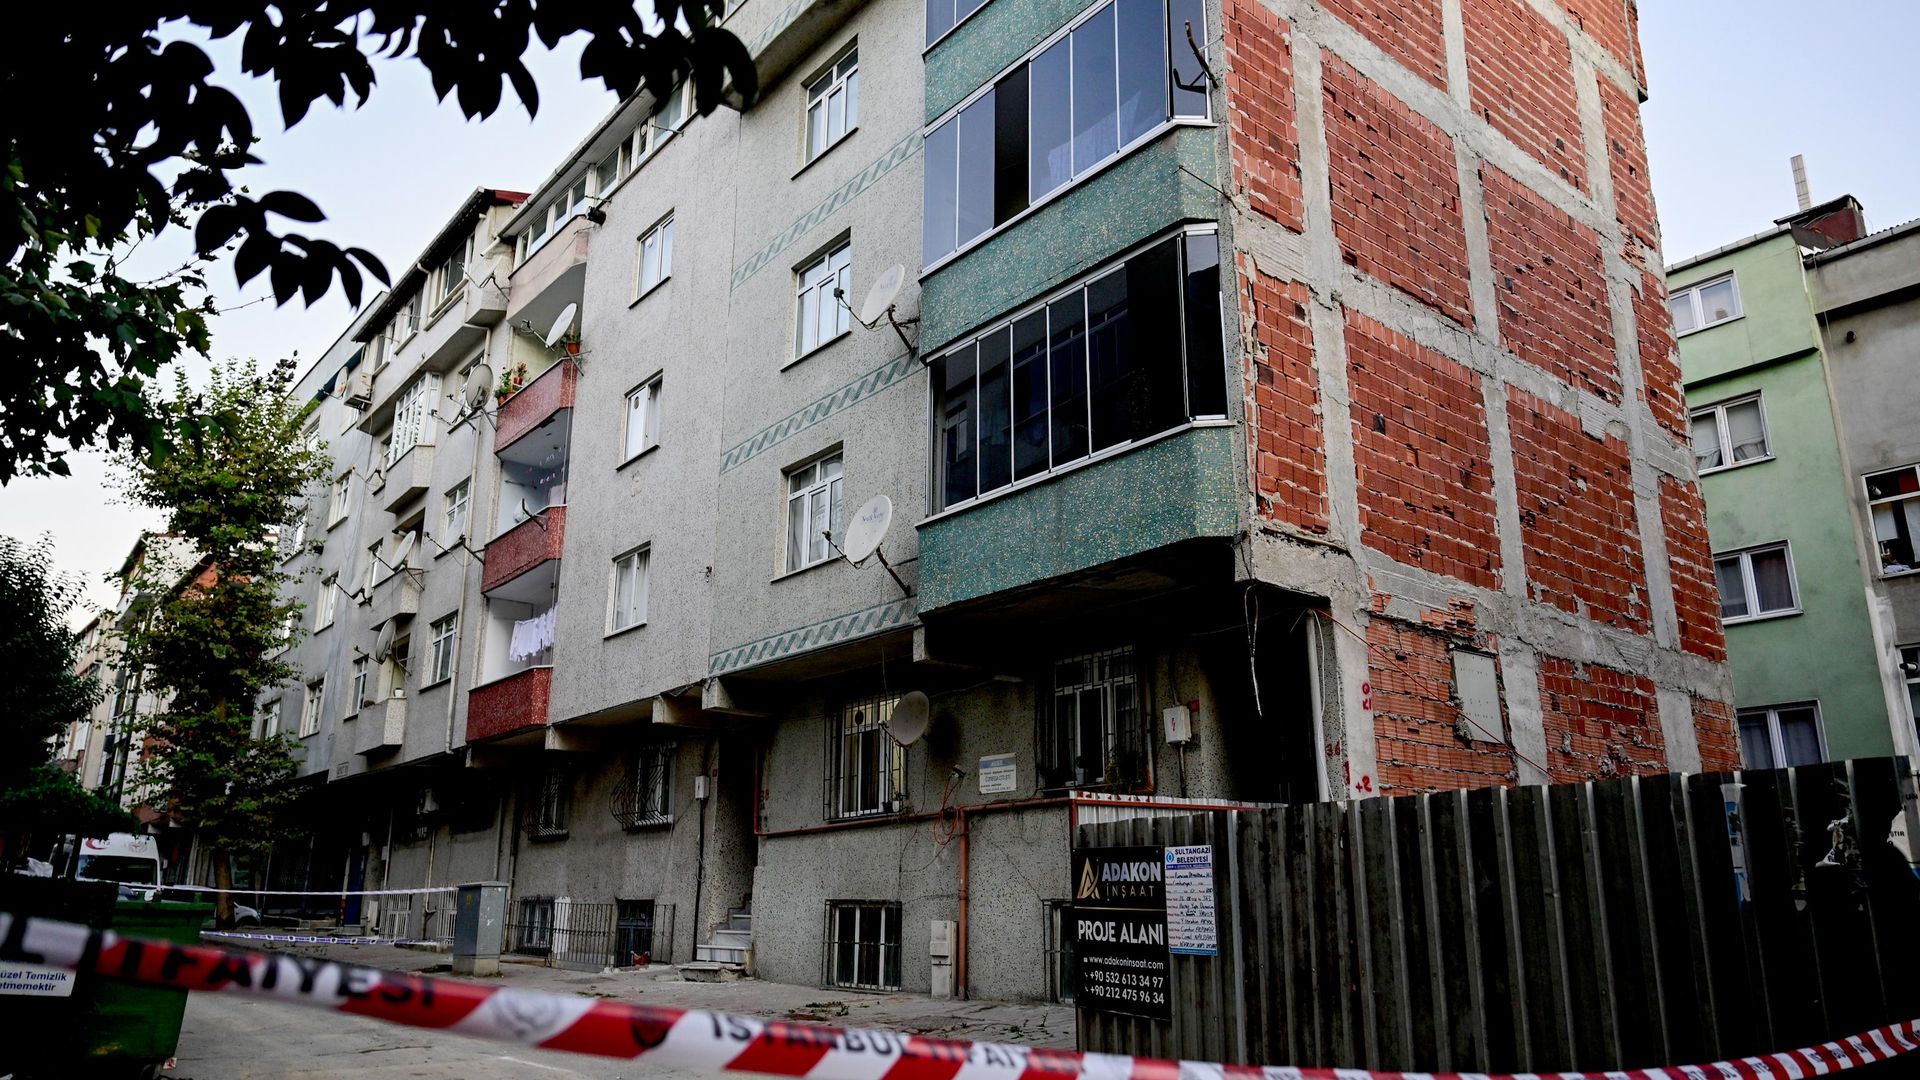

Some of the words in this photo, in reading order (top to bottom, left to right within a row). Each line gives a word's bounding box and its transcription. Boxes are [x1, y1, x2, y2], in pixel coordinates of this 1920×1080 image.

[1175, 846, 1211, 855] SULTANGAZİ
[1177, 855, 1209, 863] BELEDİYESİ
[1102, 862, 1161, 882] ADAKON
[1106, 884, 1155, 899] İNŞAAT
[1078, 919, 1117, 943] PROJE
[1120, 922, 1164, 946] ALANI
[1089, 956, 1164, 970] www.adakoninsaat.com
[25, 971, 67, 981] Temizlik
[1090, 971, 1104, 983] +90
[1106, 972, 1120, 984] 532
[1122, 974, 1137, 985] 613
[1139, 975, 1151, 987] 34
[1153, 977, 1164, 988] 97
[1090, 986, 1104, 997] +90
[1106, 987, 1120, 999] 212
[1122, 988, 1138, 1001] 475
[1140, 990, 1151, 1003] 96
[1153, 991, 1165, 1004] 34
